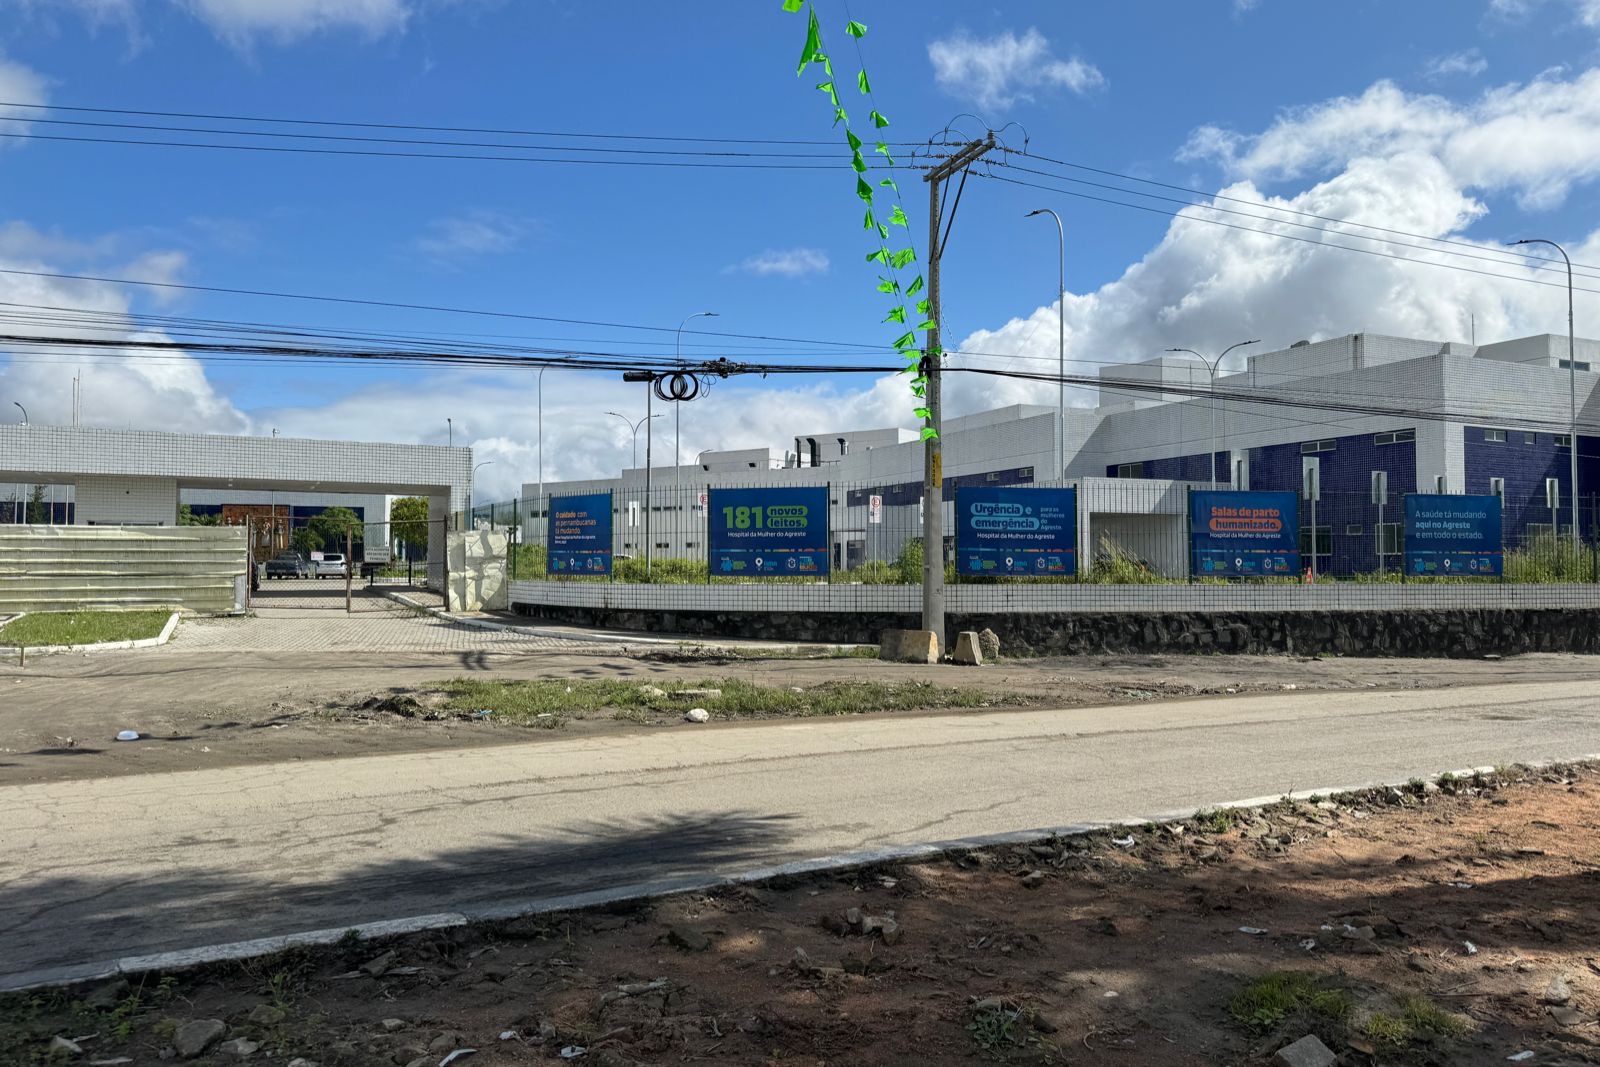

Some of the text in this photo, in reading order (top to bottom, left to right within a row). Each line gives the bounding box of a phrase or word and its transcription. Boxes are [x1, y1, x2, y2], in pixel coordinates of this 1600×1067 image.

[975, 504, 1032, 514] Urgência e
[1212, 506, 1280, 518] Salas de parto
[723, 506, 763, 528] 181
[975, 518, 1034, 529] emergência
[1216, 520, 1278, 529] humanizado.
[1416, 521, 1431, 529] aqui
[1442, 521, 1470, 529] Agreste
